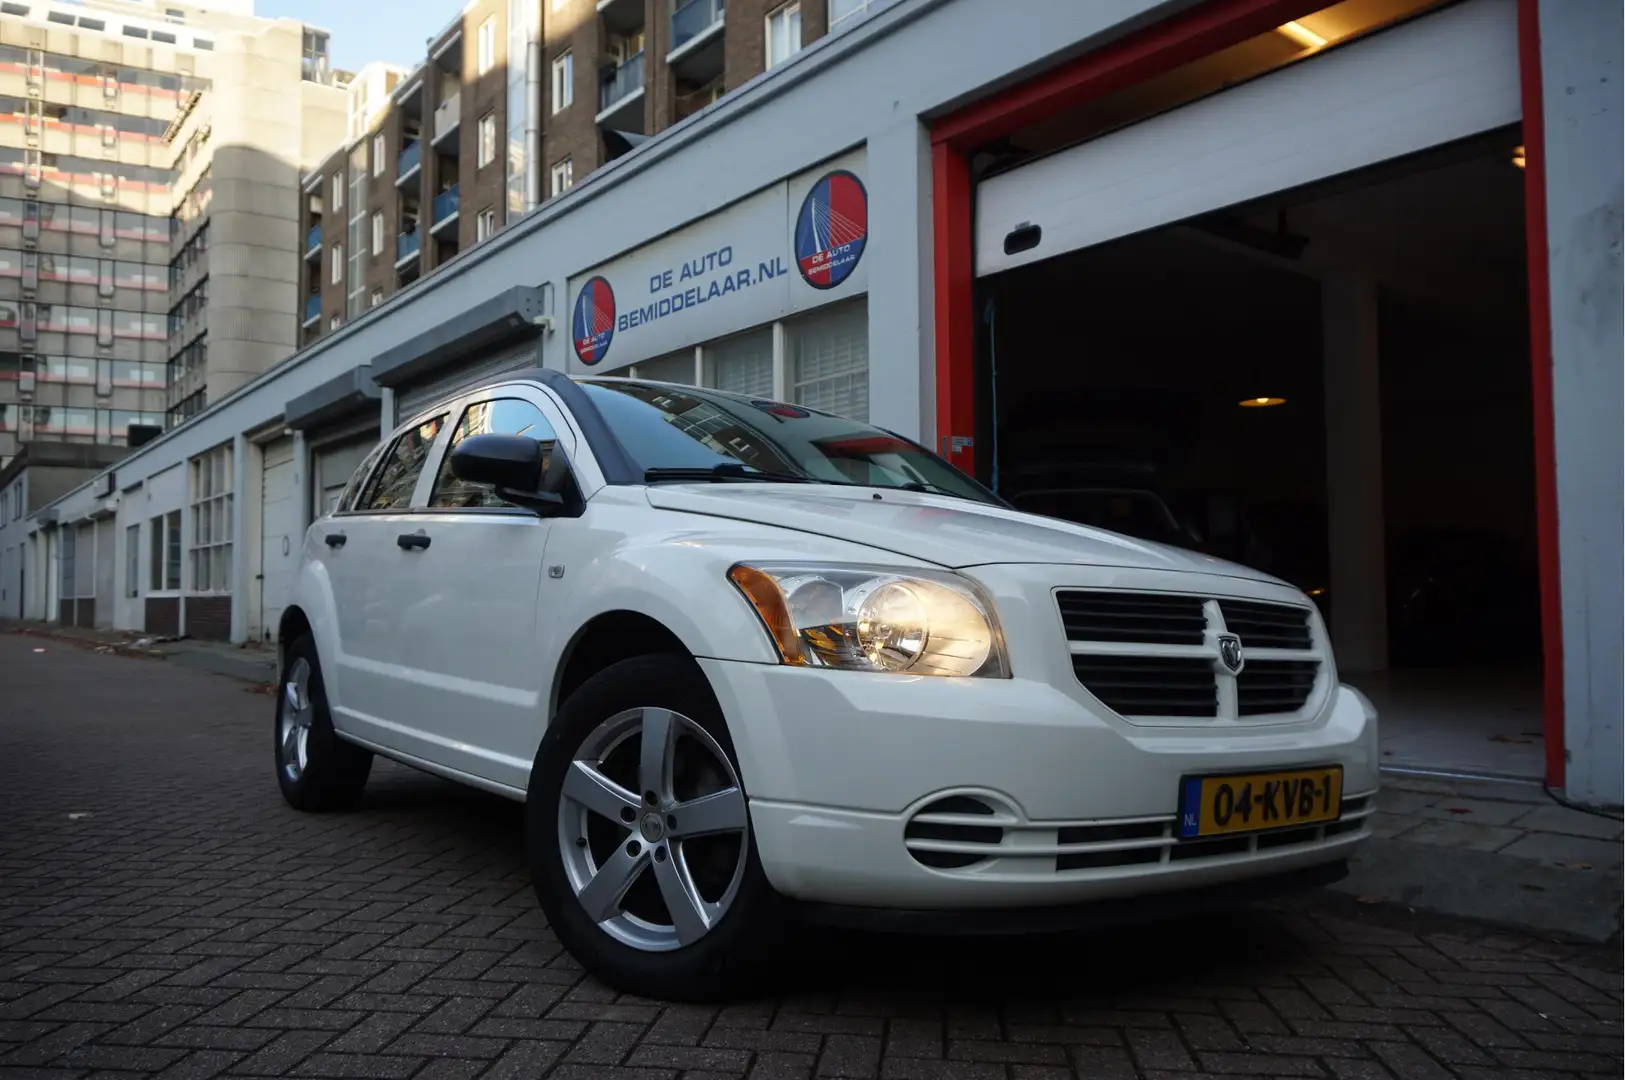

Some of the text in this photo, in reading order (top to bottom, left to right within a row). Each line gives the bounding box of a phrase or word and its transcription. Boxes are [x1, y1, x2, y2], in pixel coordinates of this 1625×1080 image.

[650, 246, 733, 294] DE AUTO
[808, 254, 855, 275] BEMIDDELAAR
[812, 244, 851, 265] DE AUTO
[618, 257, 788, 332] BEMIDDELAAR.NL
[1214, 775, 1331, 827] 04-KVB-1
[1184, 813, 1197, 827] NL
